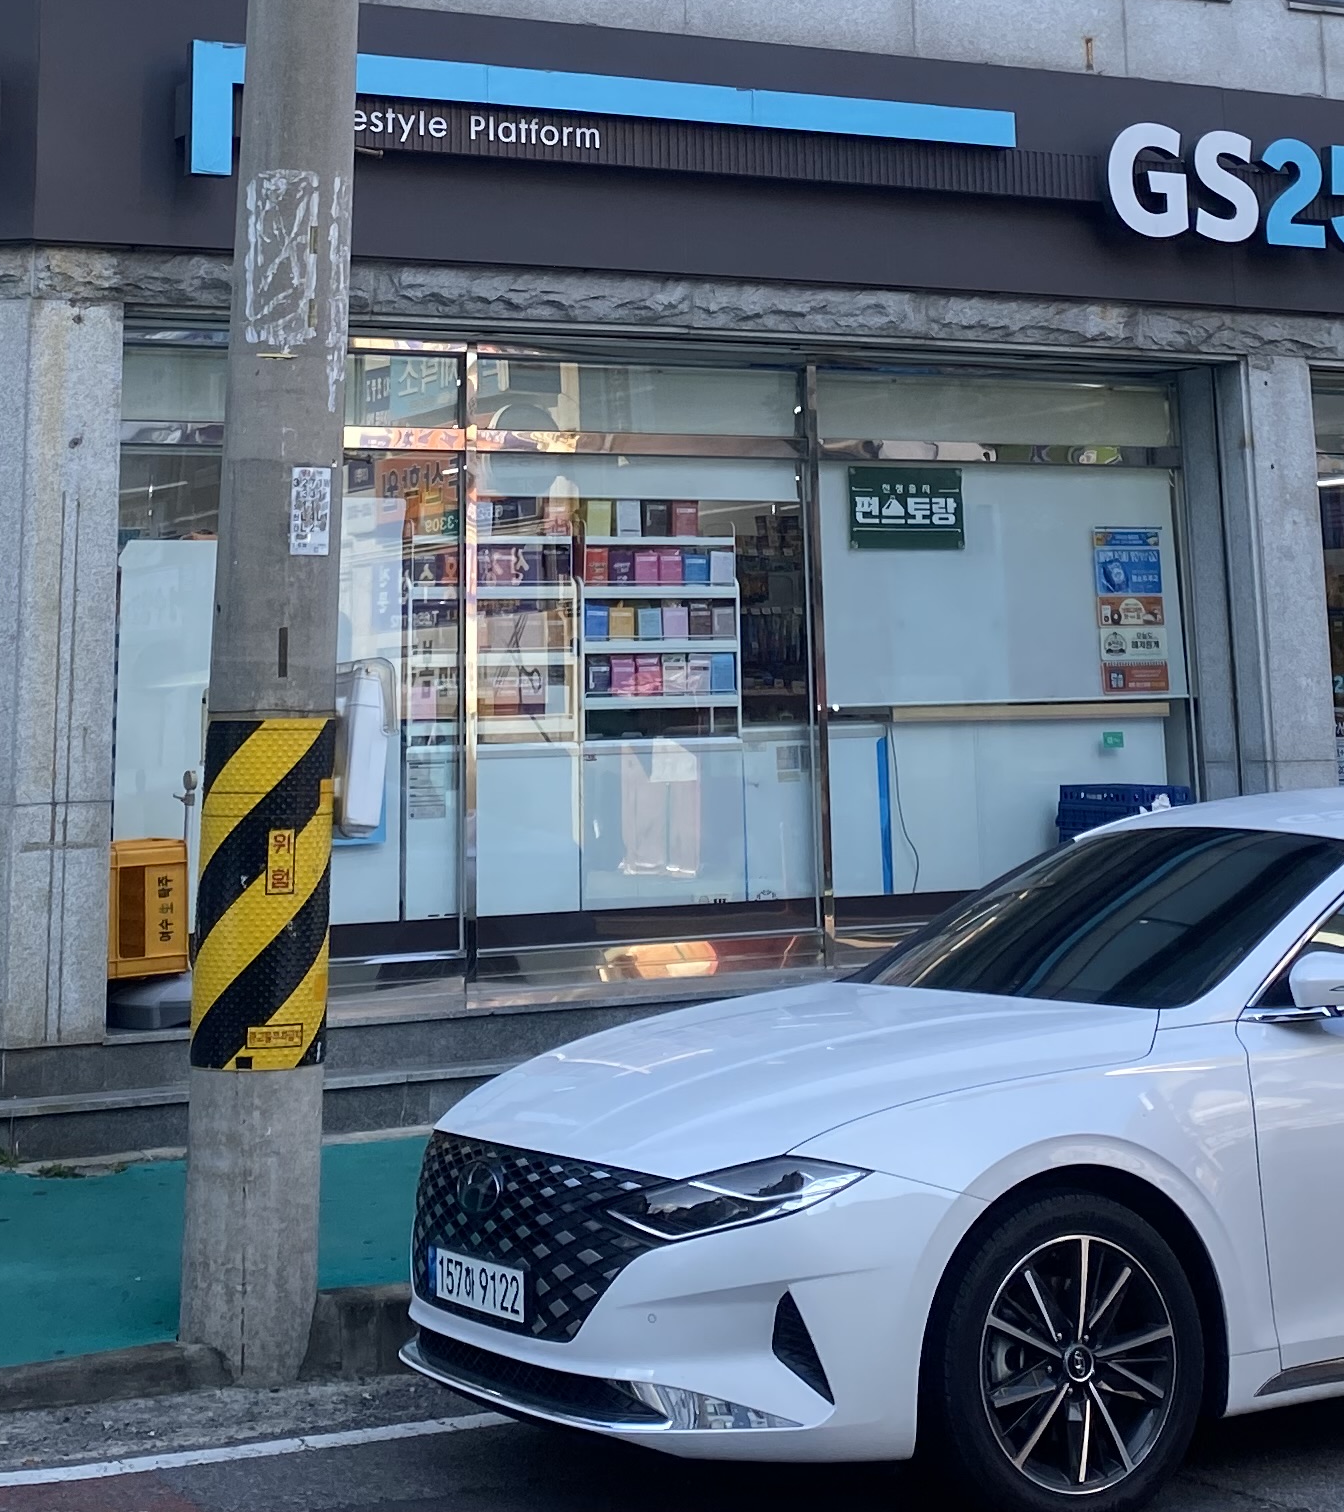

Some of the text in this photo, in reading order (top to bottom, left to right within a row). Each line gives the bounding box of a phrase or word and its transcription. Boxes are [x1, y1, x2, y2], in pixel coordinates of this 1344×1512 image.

[354, 106, 602, 150] estyle Platform
[854, 494, 957, 525] 편스토랑
[271, 833, 291, 890] 위험
[438, 1255, 521, 1316] 157하 9122
